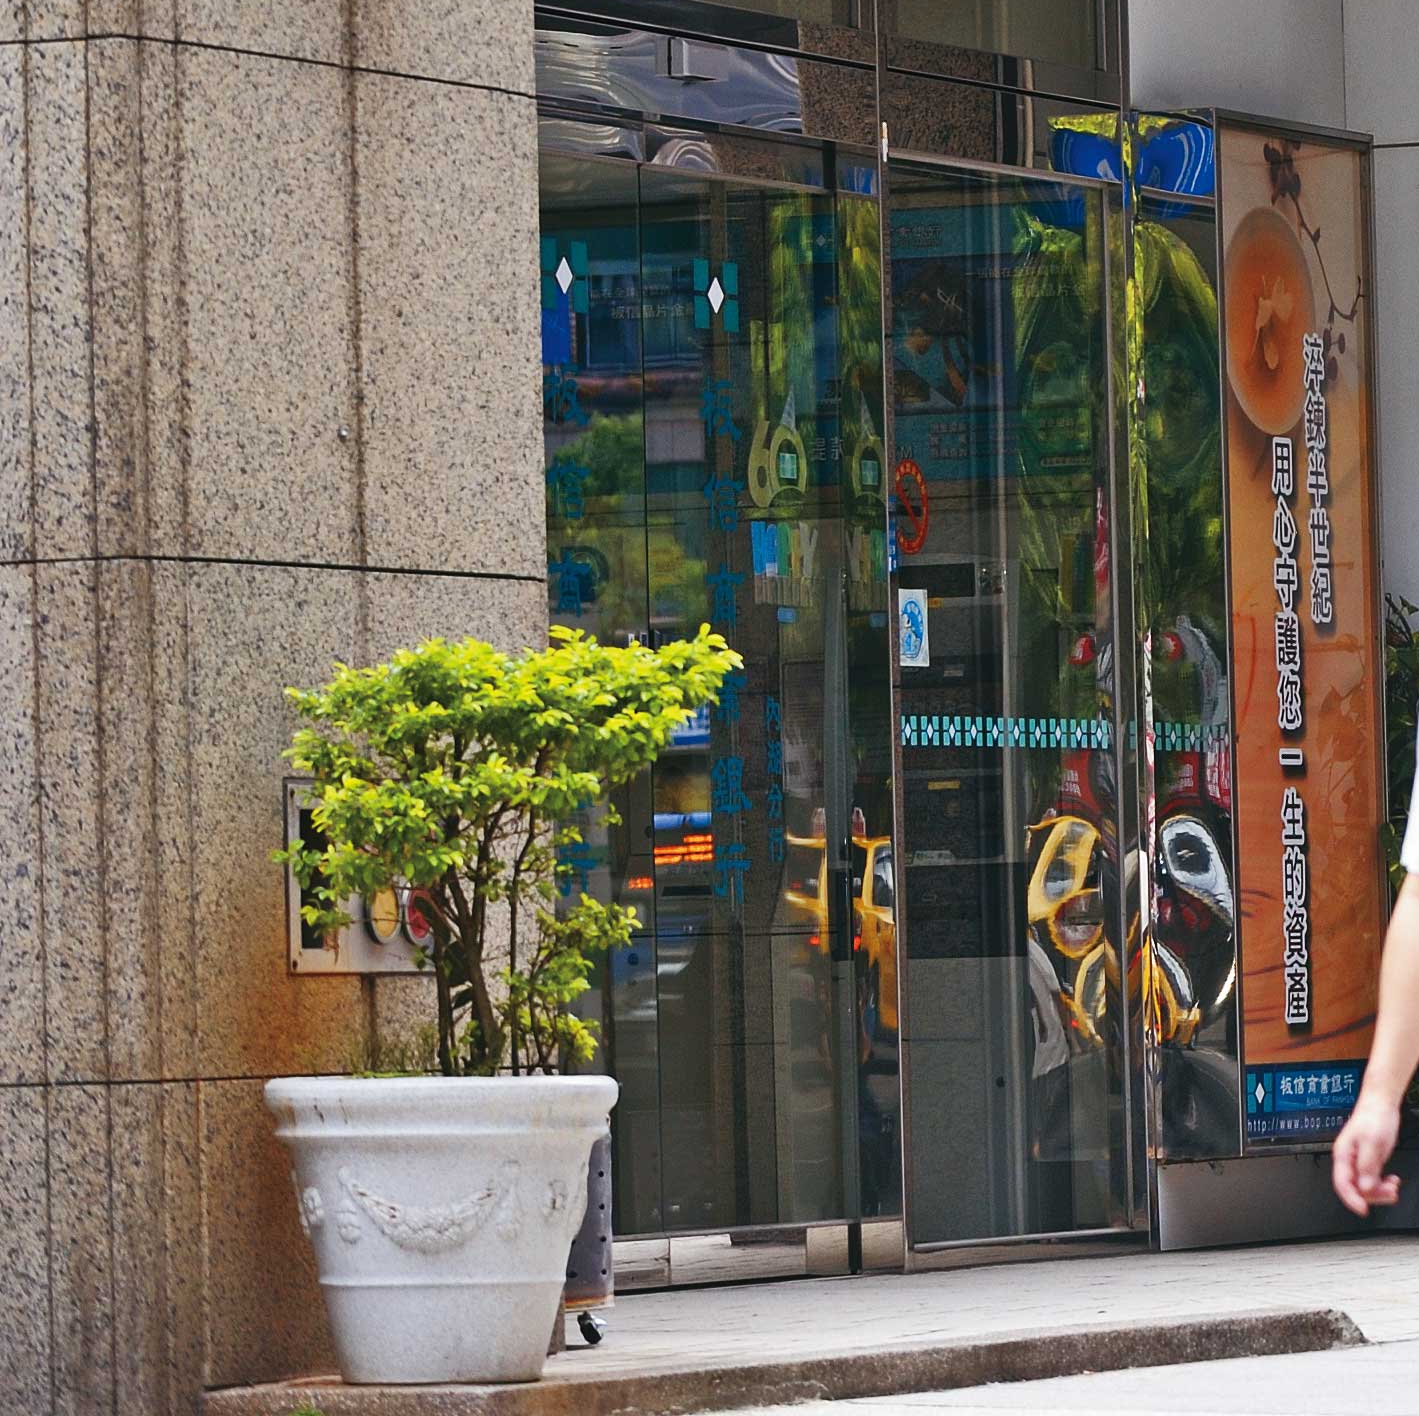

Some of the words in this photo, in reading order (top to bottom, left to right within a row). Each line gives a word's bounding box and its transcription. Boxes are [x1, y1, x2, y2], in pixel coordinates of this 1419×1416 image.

[1303, 333, 1333, 624] 淬鍊半世紀
